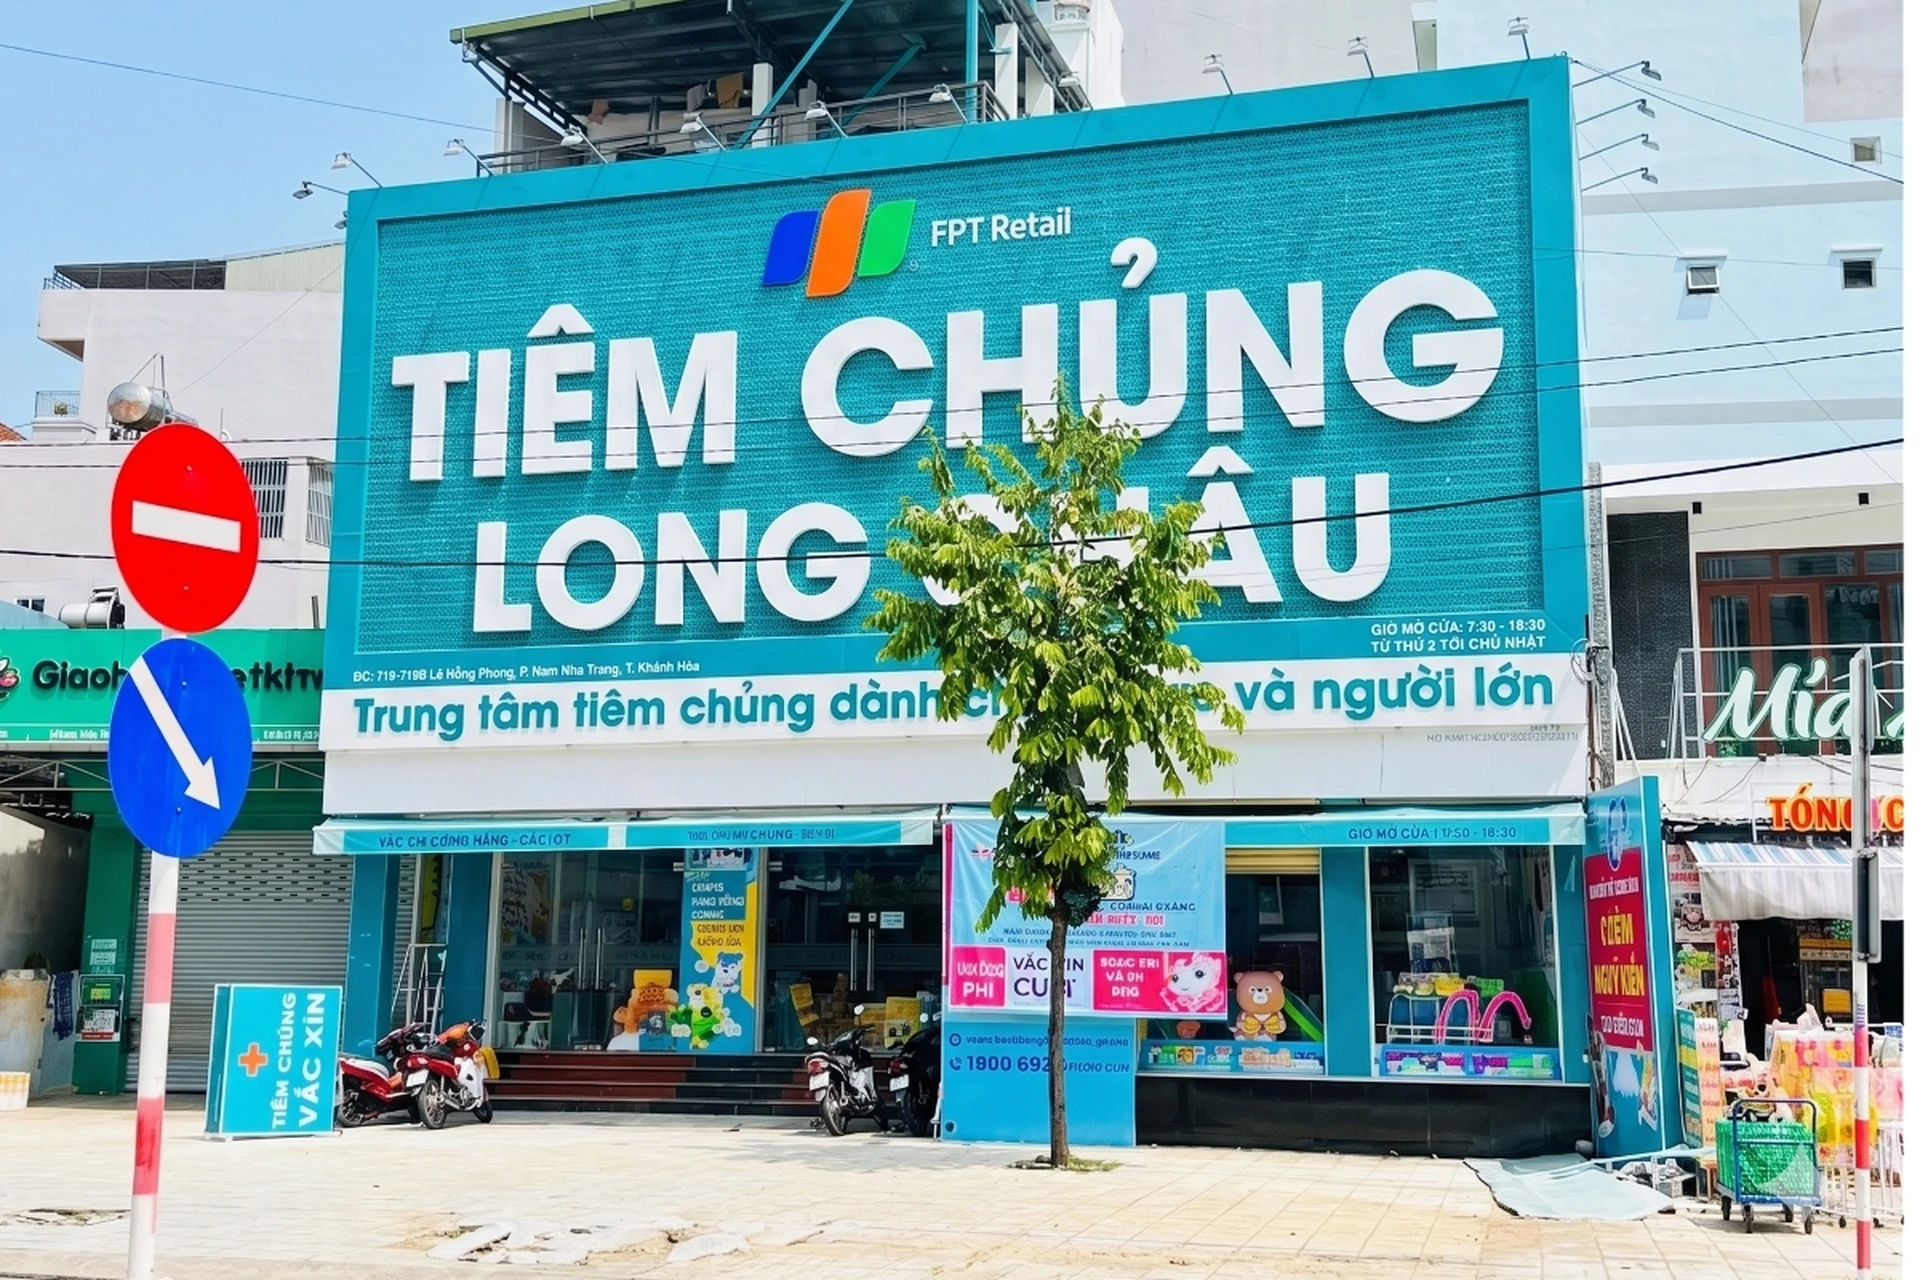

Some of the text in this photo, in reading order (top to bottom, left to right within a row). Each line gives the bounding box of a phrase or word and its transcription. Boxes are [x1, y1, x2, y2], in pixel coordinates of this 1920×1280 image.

[931, 206, 1071, 247] FPT Retail
[391, 237, 1505, 482] TIÊM CHỦNG
[471, 502, 871, 635] LONG
[1467, 620, 1496, 632] 7:30
[1509, 619, 1545, 632] 18:30
[1428, 642, 1436, 652] 2
[353, 671, 374, 683] ĐC:
[377, 669, 427, 682] 719-719B
[478, 667, 516, 681] Phong,
[520, 665, 529, 677] P.
[532, 665, 558, 676] Nam
[561, 664, 584, 676] Nha
[587, 663, 622, 678] Trang,
[626, 662, 635, 674] T.
[638, 661, 674, 673] Khánh
[354, 698, 465, 741] Trung
[478, 691, 559, 730] tâm
[574, 688, 665, 728] tiêm
[680, 680, 815, 732] chủng
[830, 678, 940, 720] dành
[1234, 667, 1295, 711] và
[1313, 664, 1455, 721] người
[1475, 661, 1553, 706] lớn
[1482, 827, 1517, 838] 18:30
[962, 982, 995, 998] PHI
